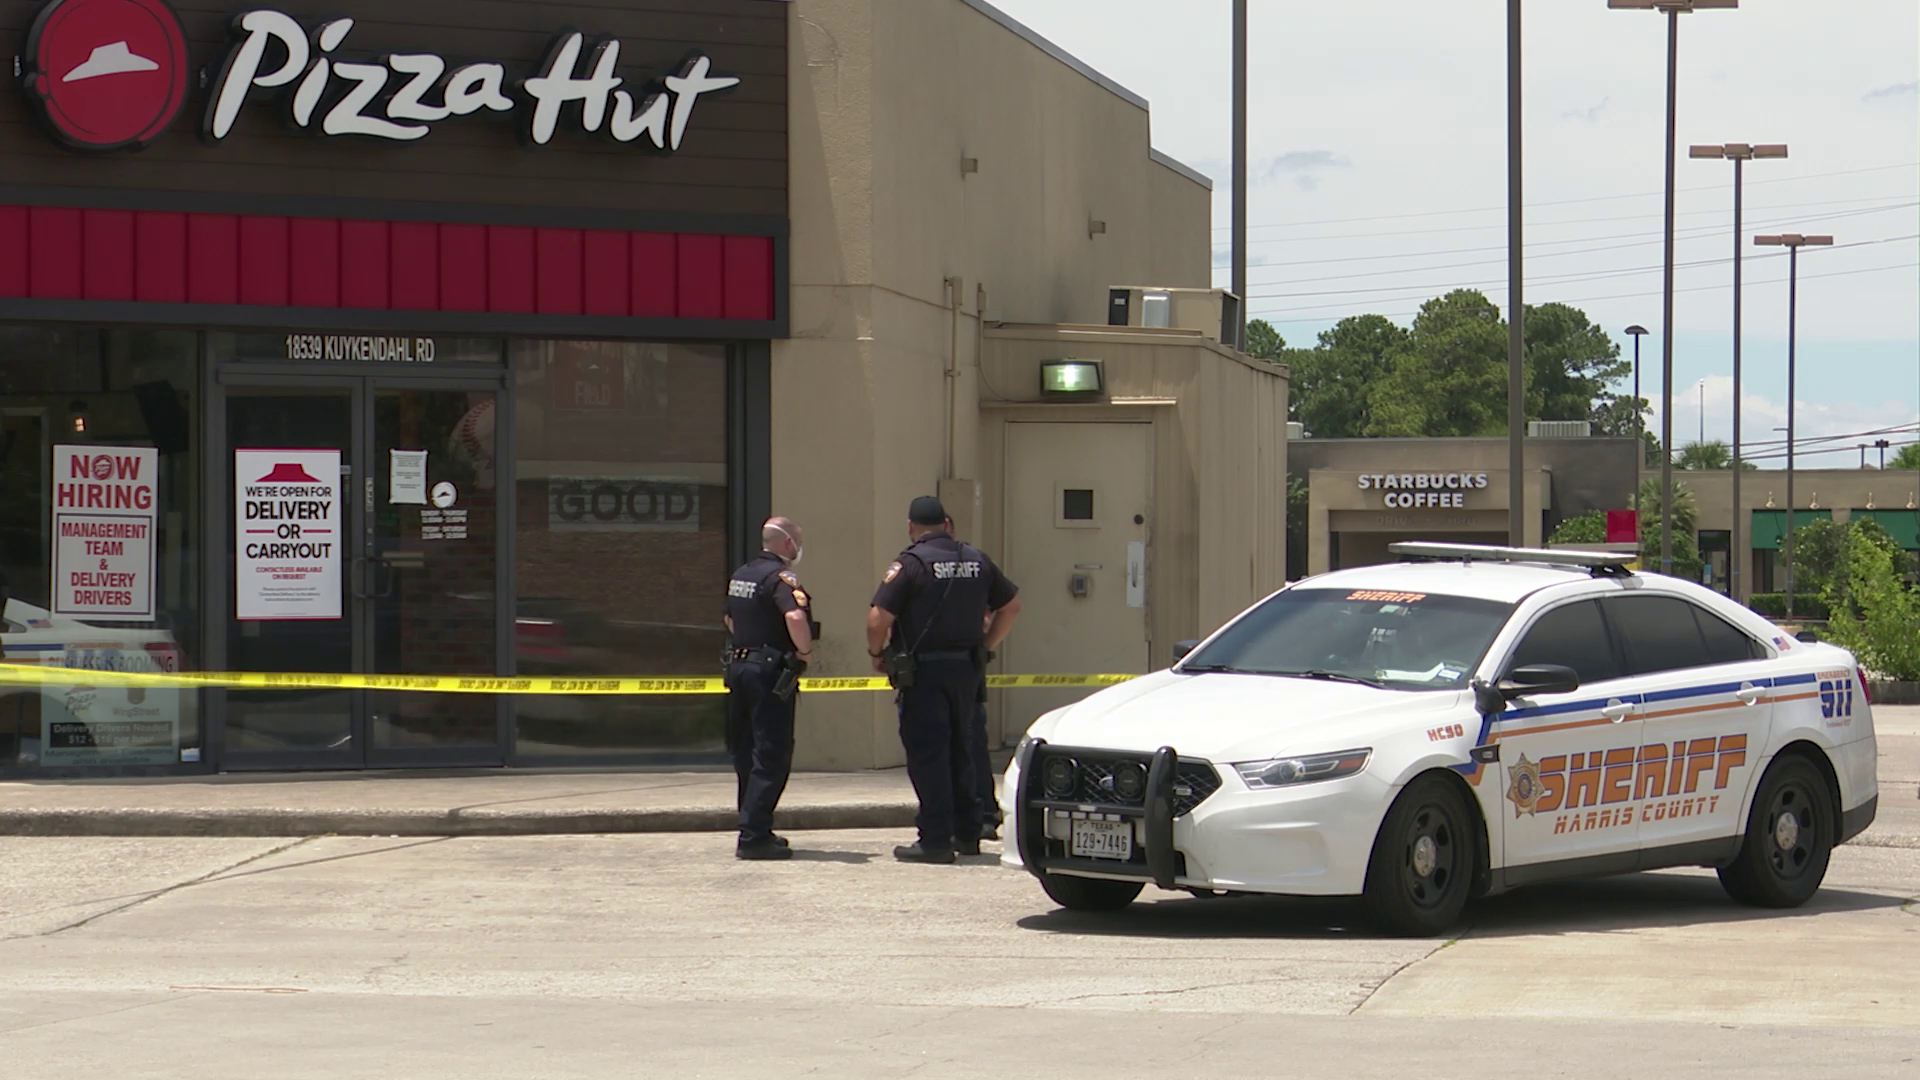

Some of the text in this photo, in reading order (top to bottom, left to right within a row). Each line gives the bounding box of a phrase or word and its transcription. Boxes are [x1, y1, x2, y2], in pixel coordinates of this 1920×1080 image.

[213, 9, 741, 150] Pizza Hut
[285, 334, 435, 362] 18539 KUYKENDAHL RD
[71, 454, 141, 480] NOW
[1358, 473, 1488, 489] STARBUCKS
[58, 483, 152, 509] HIRING
[245, 486, 332, 497] WE'RE OPEN FOR
[1384, 492, 1464, 508] COFFEE
[246, 501, 331, 519] DELIVERY
[556, 484, 694, 521] GOOD
[61, 522, 147, 539] MANAGEMENT
[277, 523, 301, 539] OR
[85, 541, 123, 556] TEAM
[246, 543, 332, 558] CARRYOUT
[99, 558, 108, 570] &
[933, 561, 980, 579] SHERIFF
[71, 572, 136, 587] DELIVERY
[728, 579, 757, 599] SHERIFF
[1346, 590, 1427, 603] SHERIFF
[74, 590, 132, 606] DRIVERS
[1820, 679, 1852, 718] 911
[1535, 734, 1748, 813] SHERIFF
[1553, 795, 1720, 835] HARRIS COUNTY
[1091, 822, 1113, 830] TEXAS
